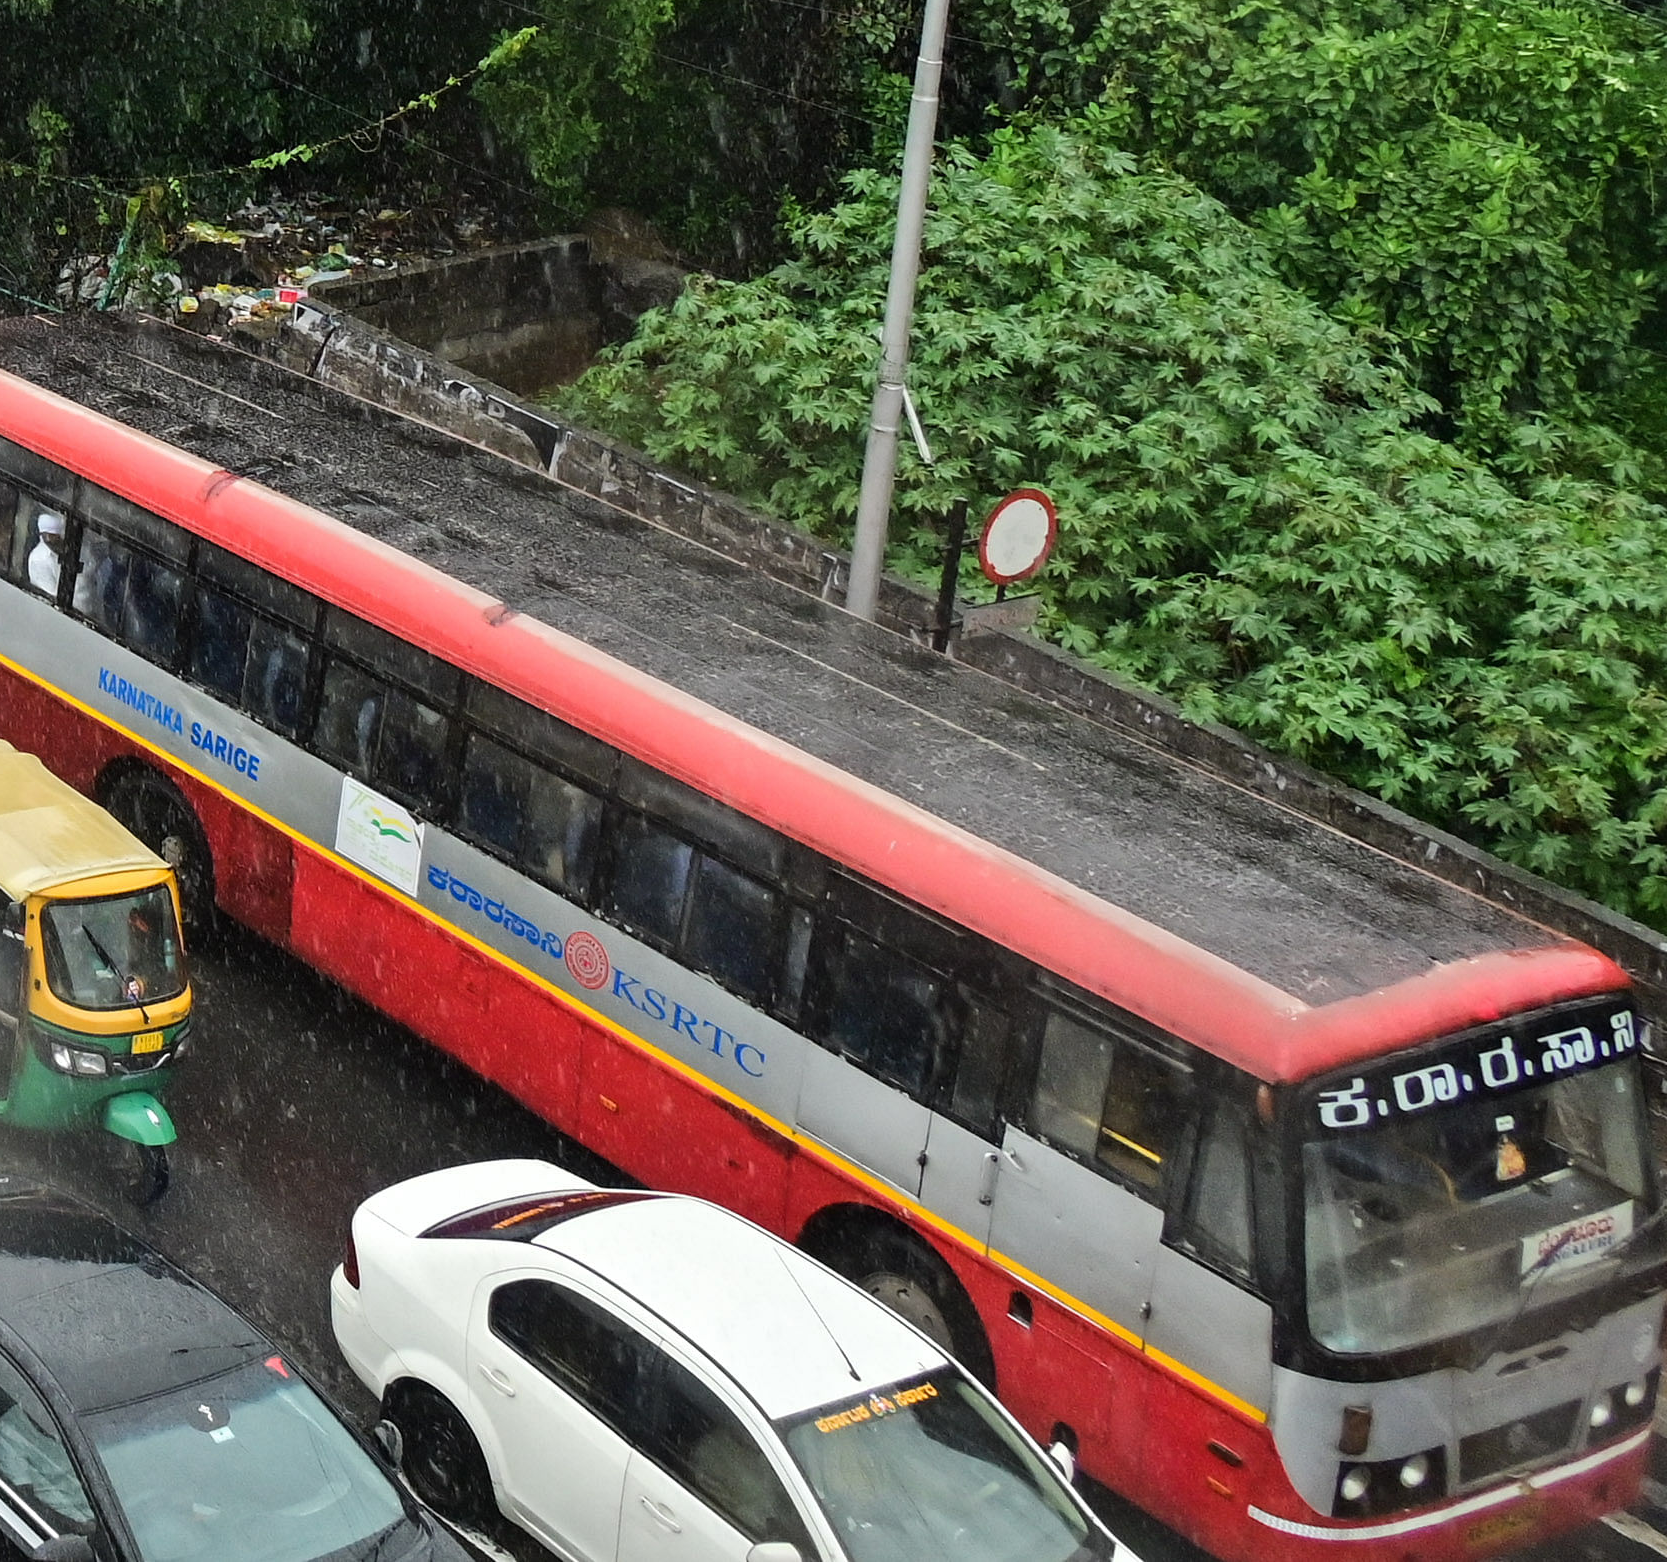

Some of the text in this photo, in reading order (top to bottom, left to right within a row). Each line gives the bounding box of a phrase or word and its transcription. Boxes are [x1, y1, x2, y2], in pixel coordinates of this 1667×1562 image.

[98, 667, 260, 781] KARNATAKA SARIGE
[427, 864, 563, 959] ಕರಾರಸಾನಿ
[610, 969, 768, 1079] KSRTC
